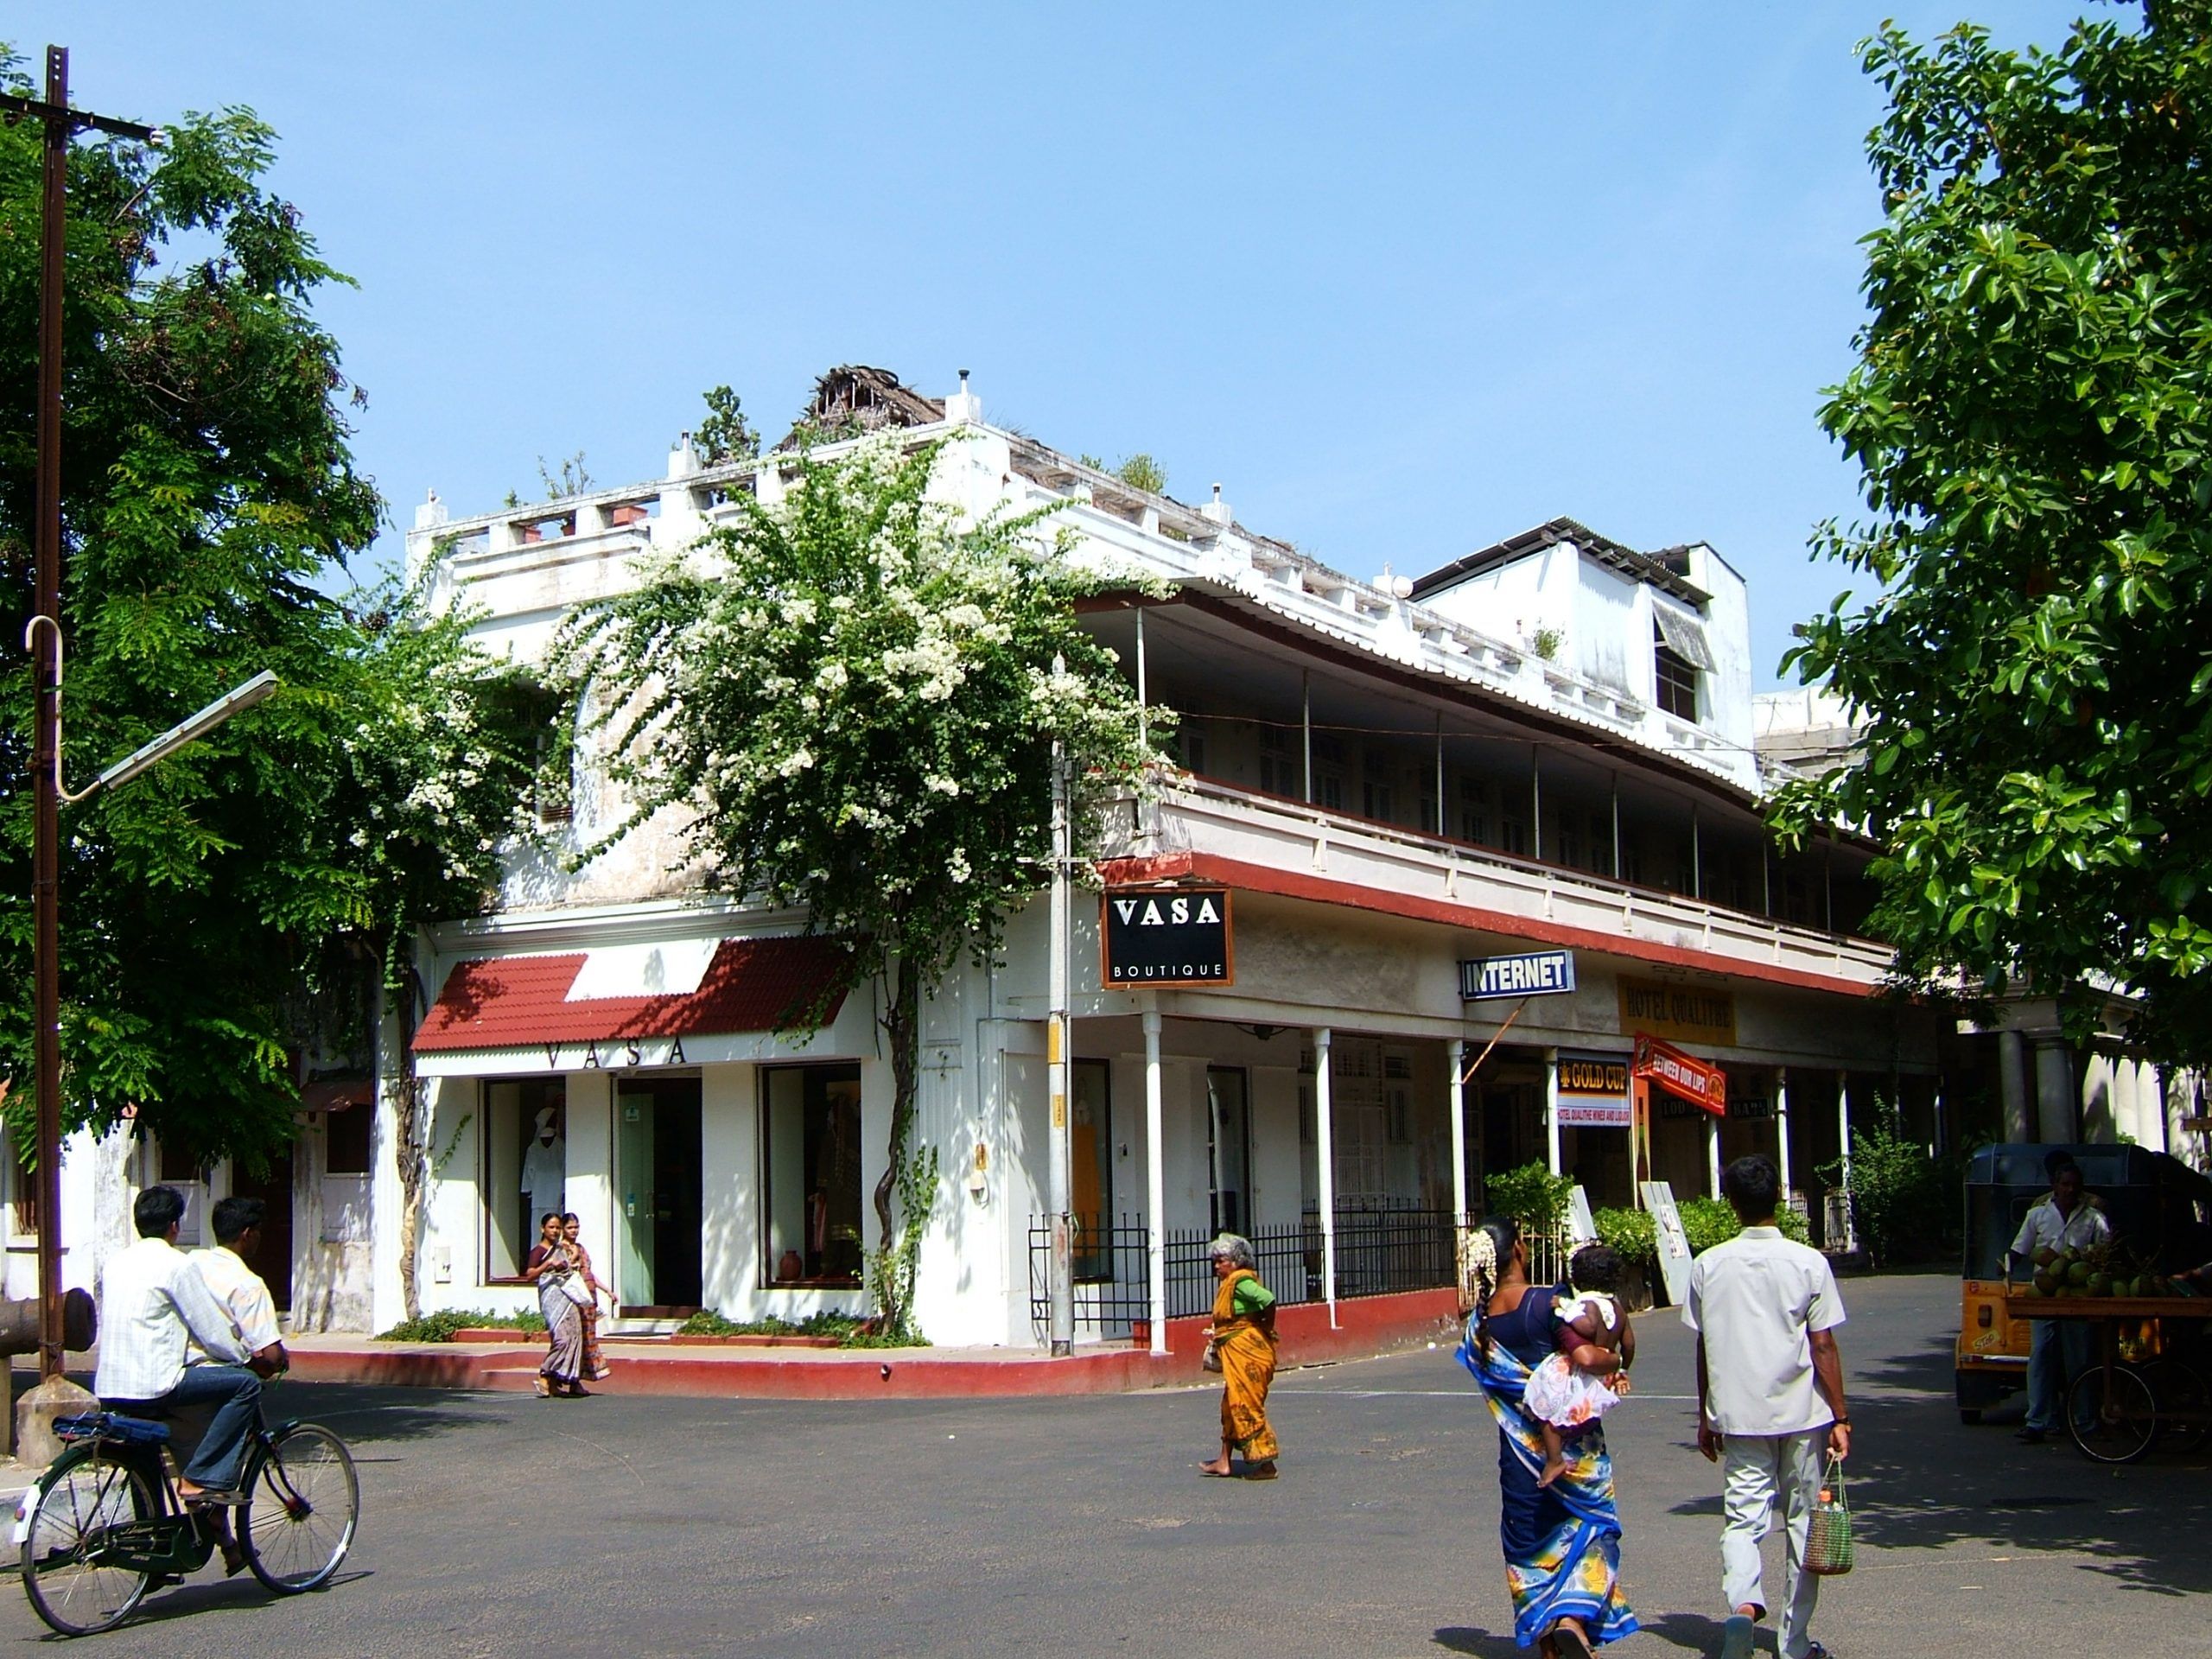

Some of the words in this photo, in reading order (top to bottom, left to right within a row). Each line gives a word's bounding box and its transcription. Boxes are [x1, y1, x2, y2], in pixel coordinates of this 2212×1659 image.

[1114, 898, 1220, 926] VASA
[1114, 964, 1221, 977] BOUTIQUE
[1465, 956, 1564, 993] INTERNET
[1627, 986, 1669, 1020] HOTEL
[546, 1036, 686, 1070] VASA
[1573, 1063, 1605, 1089] GOLD
[1605, 1065, 1626, 1090] CUP
[1653, 1052, 1681, 1082] BETWEEN
[1680, 1065, 1693, 1088] OUR
[1693, 1072, 1706, 1094] LIPS
